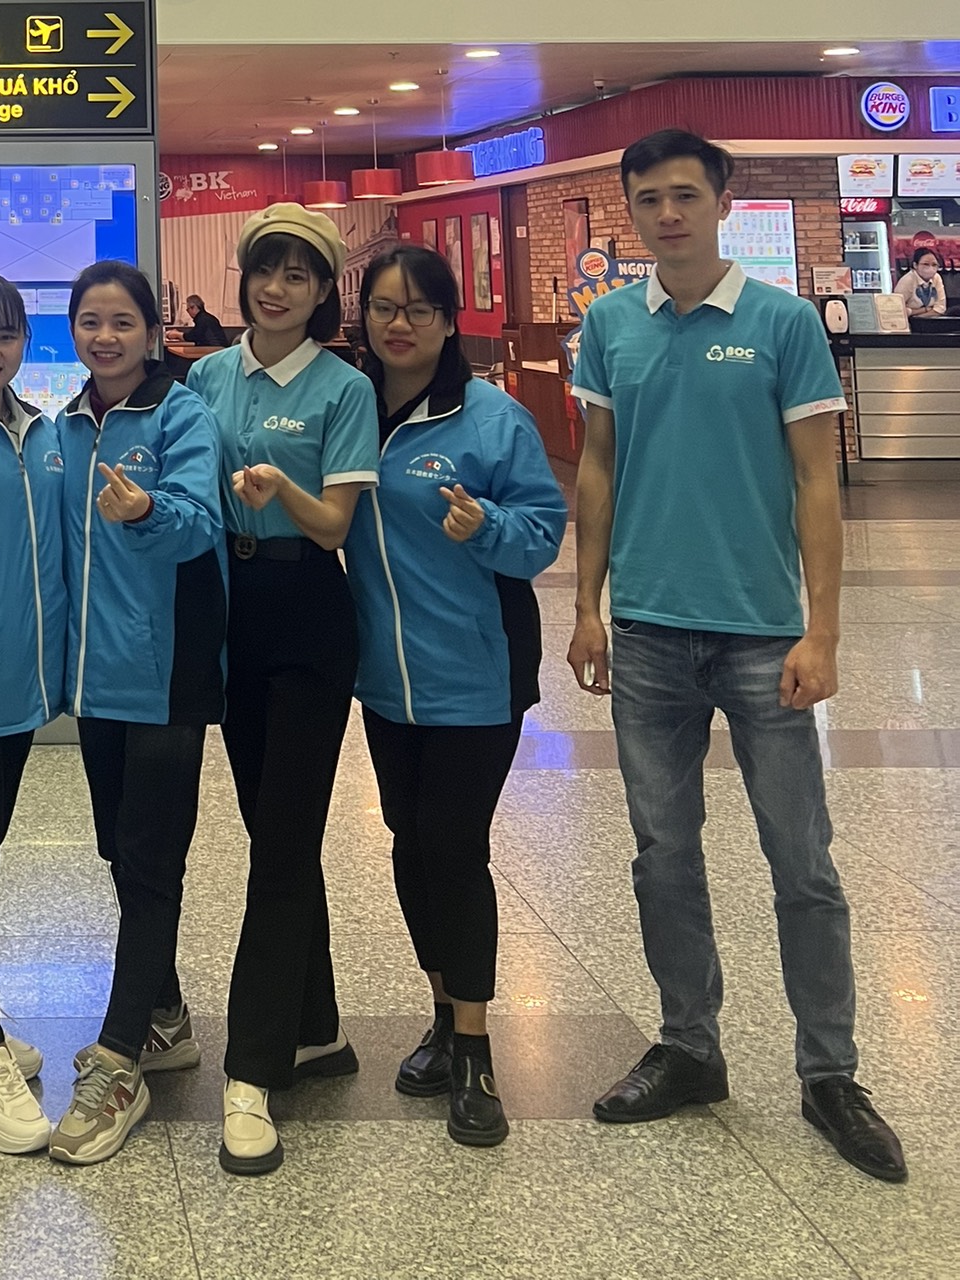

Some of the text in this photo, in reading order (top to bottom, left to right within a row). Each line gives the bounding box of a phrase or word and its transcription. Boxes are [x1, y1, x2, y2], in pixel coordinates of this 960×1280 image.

[33, 70, 79, 95] KHỔ
[868, 102, 906, 114] KING
[189, 171, 231, 192] BK
[214, 186, 258, 201] Vietnam
[726, 345, 756, 358] BOC
[280, 416, 306, 431] BOC
